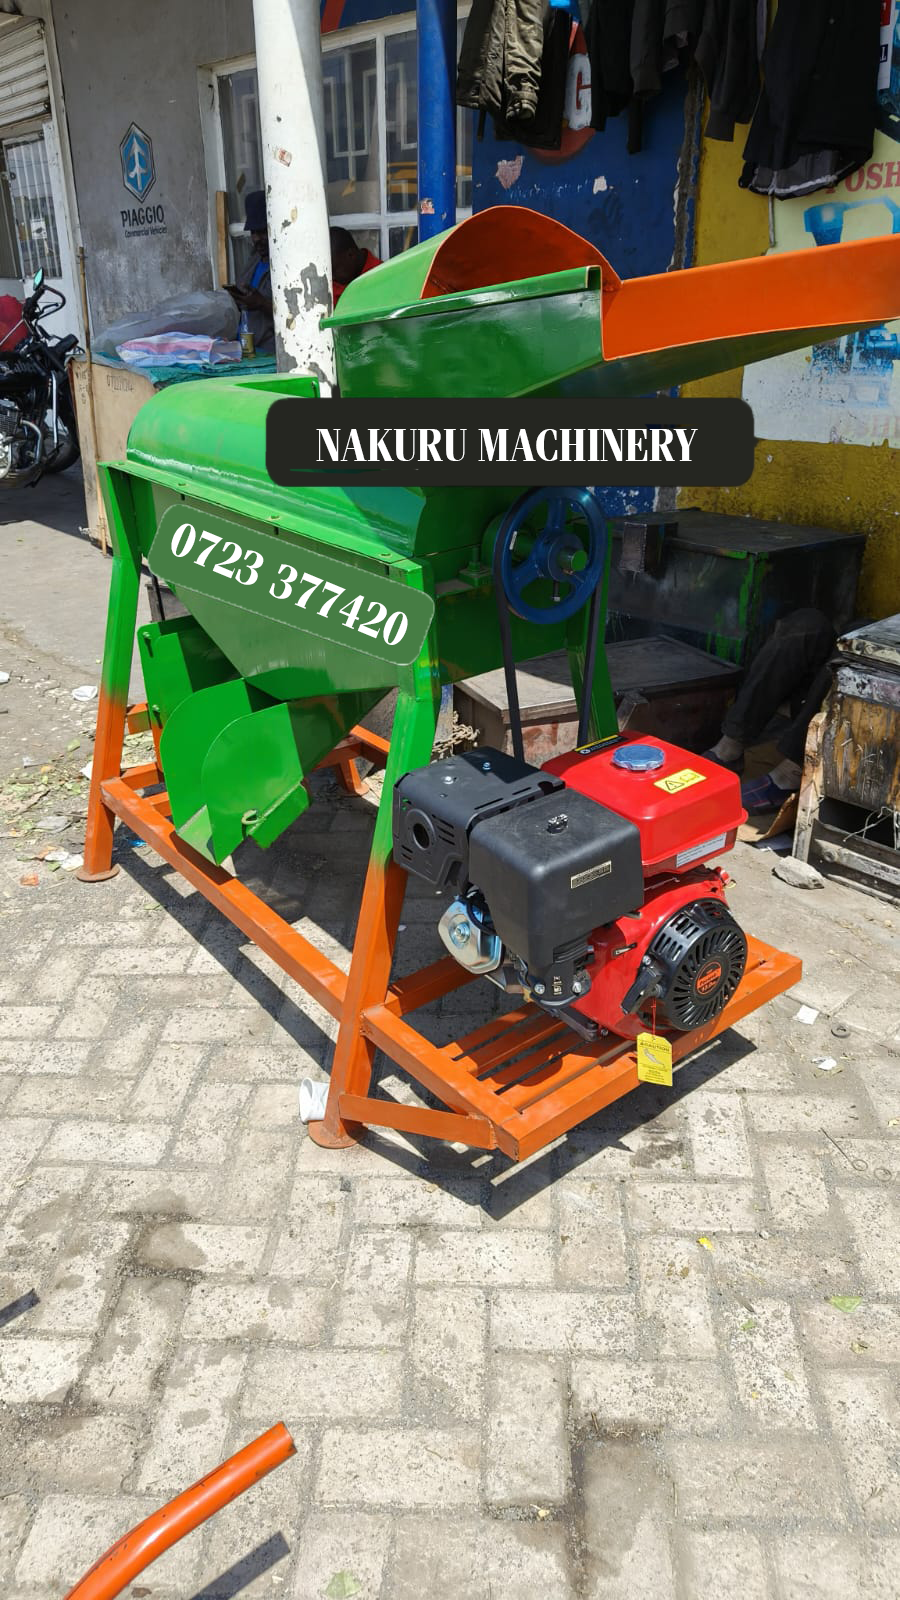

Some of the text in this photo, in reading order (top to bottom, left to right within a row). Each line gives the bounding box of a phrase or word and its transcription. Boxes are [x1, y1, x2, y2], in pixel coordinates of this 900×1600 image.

[120, 204, 164, 227] PIAGGIO
[125, 226, 167, 238] Commercial Vehicles
